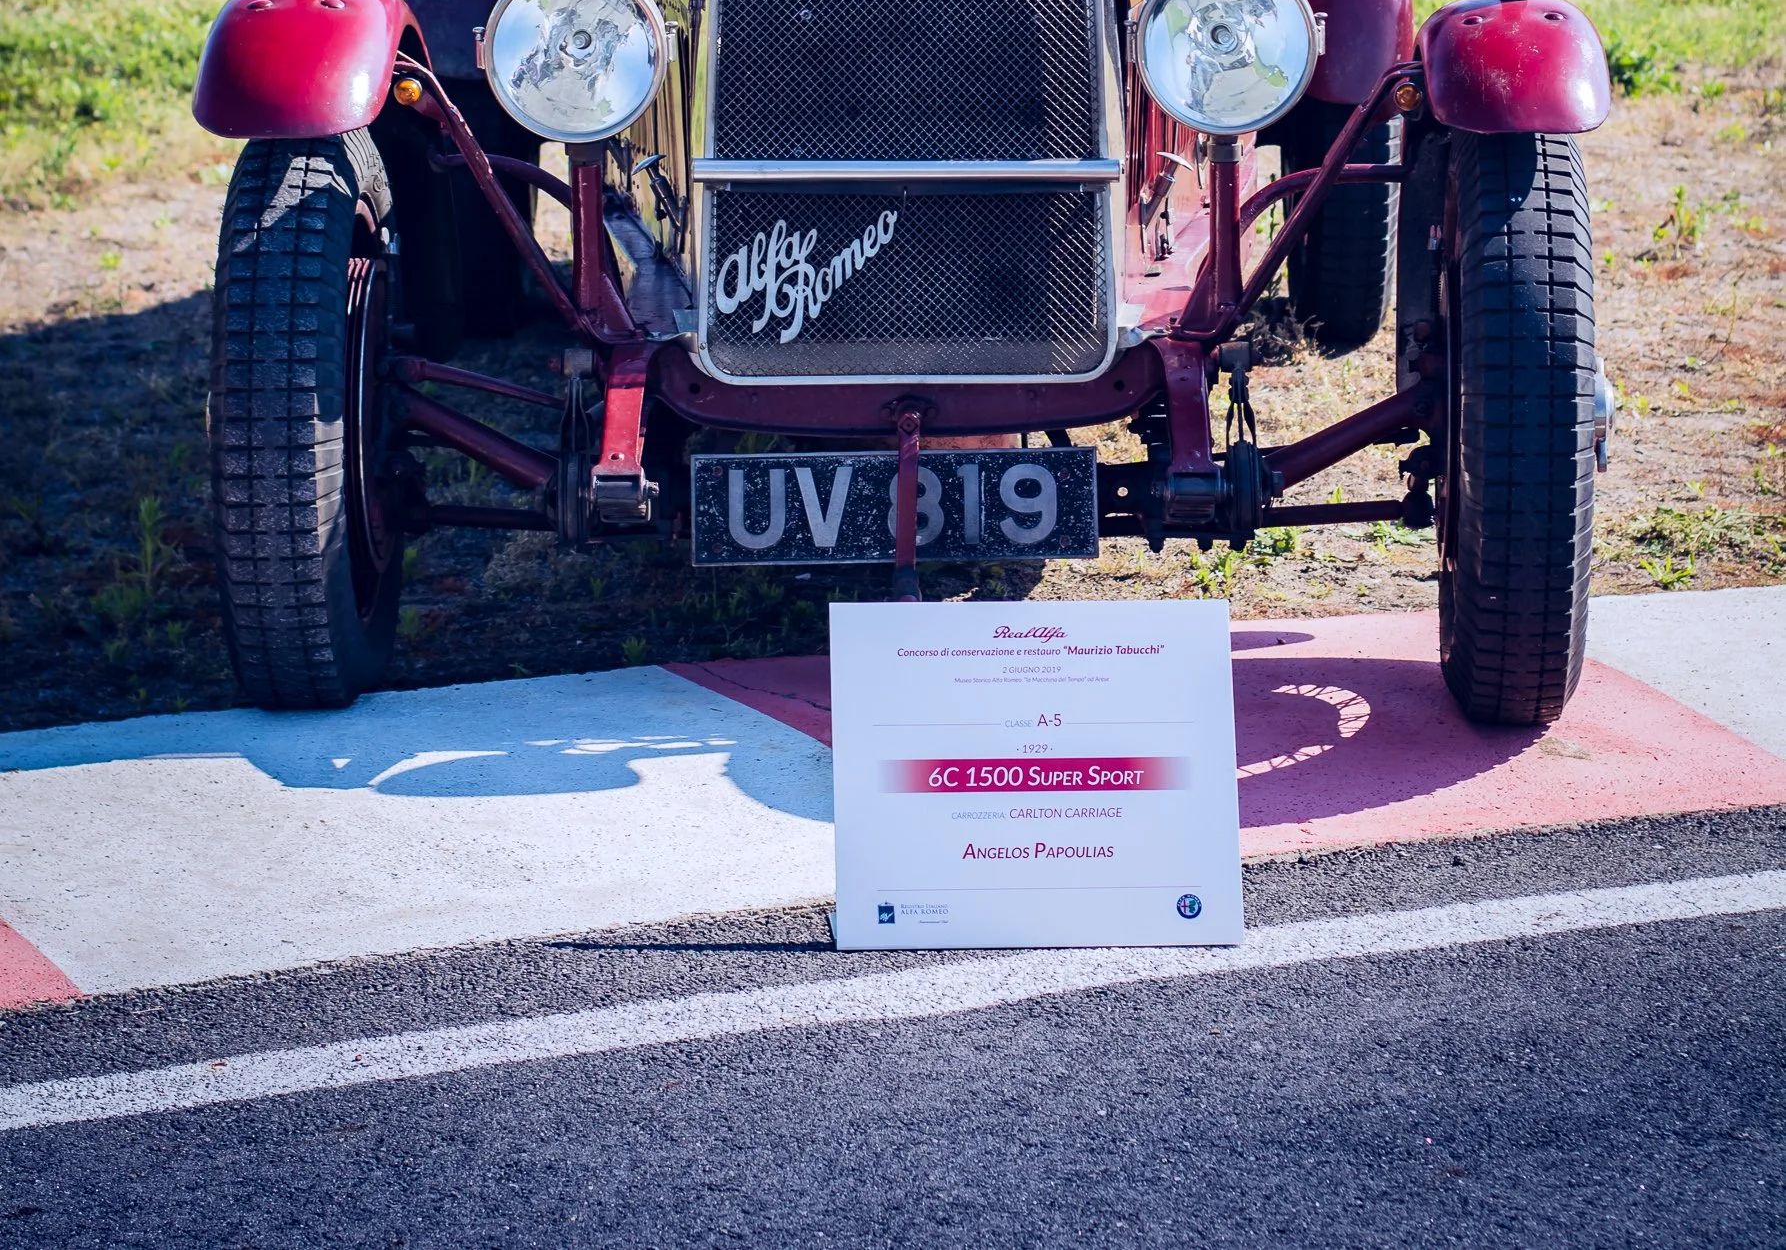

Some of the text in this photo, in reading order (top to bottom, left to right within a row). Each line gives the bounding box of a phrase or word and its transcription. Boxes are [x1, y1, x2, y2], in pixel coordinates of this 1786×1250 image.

[728, 463, 1058, 549] UV 819
[897, 648, 938, 657] Concorso
[940, 648, 949, 657] di
[951, 648, 1014, 657] conservazione
[1023, 648, 1061, 656] restauro
[1042, 665, 1061, 673] 2019
[1037, 713, 1062, 727] A-5
[928, 767, 959, 787] 6C
[965, 766, 1023, 787] 1500
[1009, 808, 1062, 819] CARLTON
[1064, 807, 1122, 818] CARRIAGE
